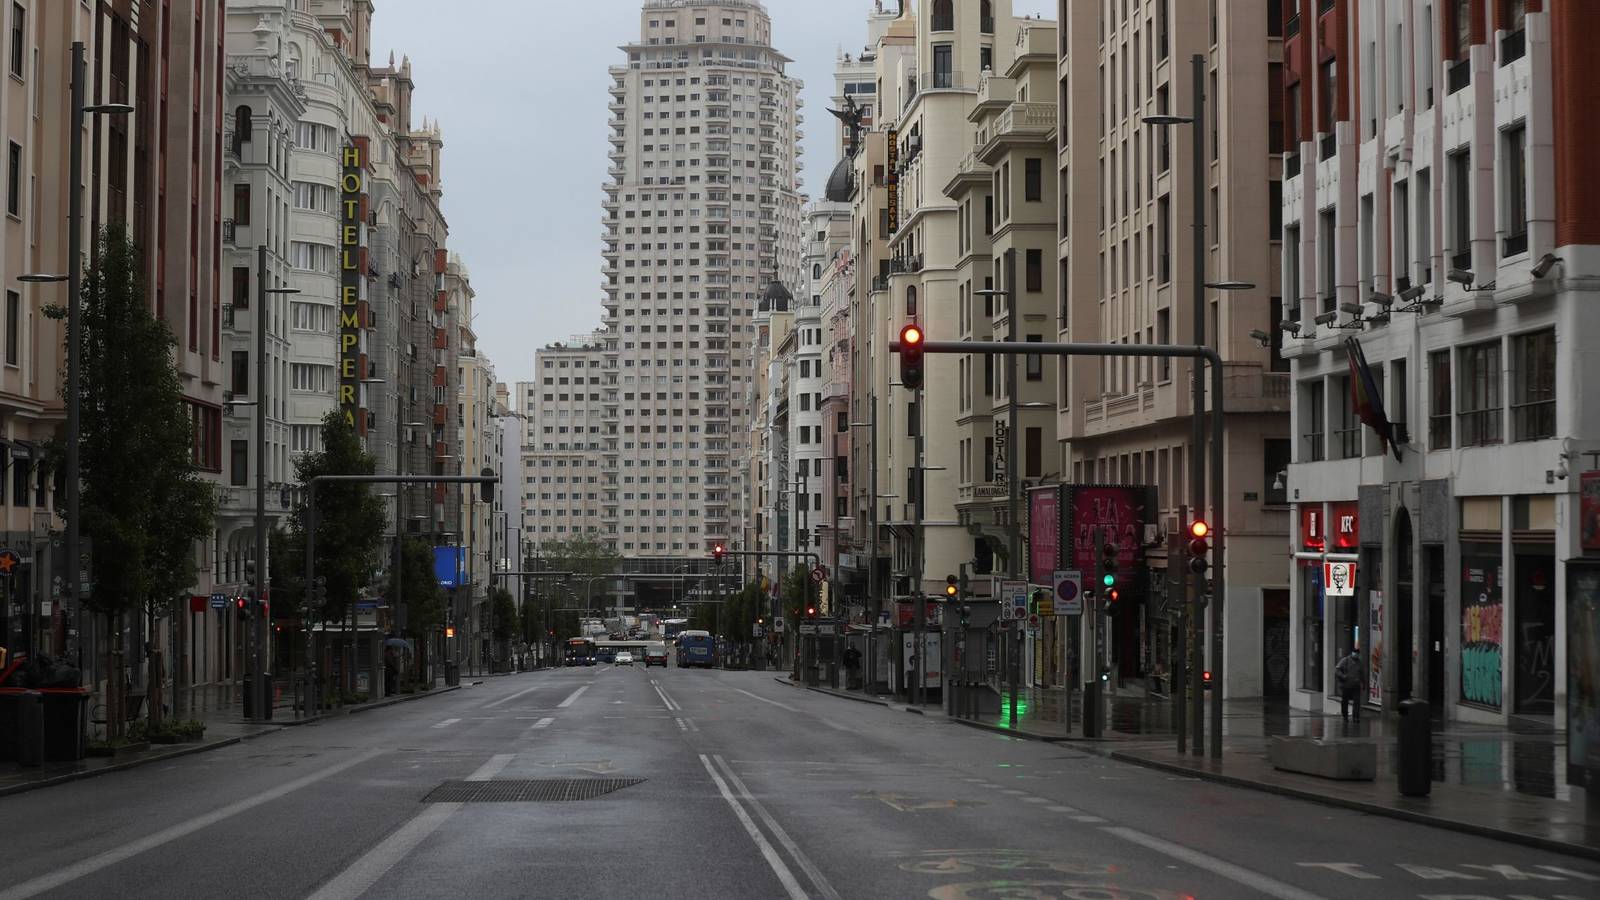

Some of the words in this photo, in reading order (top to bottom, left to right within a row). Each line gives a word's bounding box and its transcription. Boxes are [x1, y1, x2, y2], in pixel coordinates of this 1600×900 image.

[341, 147, 361, 270] HOTEL
[995, 420, 1005, 470] HOSTAL
[1341, 515, 1354, 533] KFC
